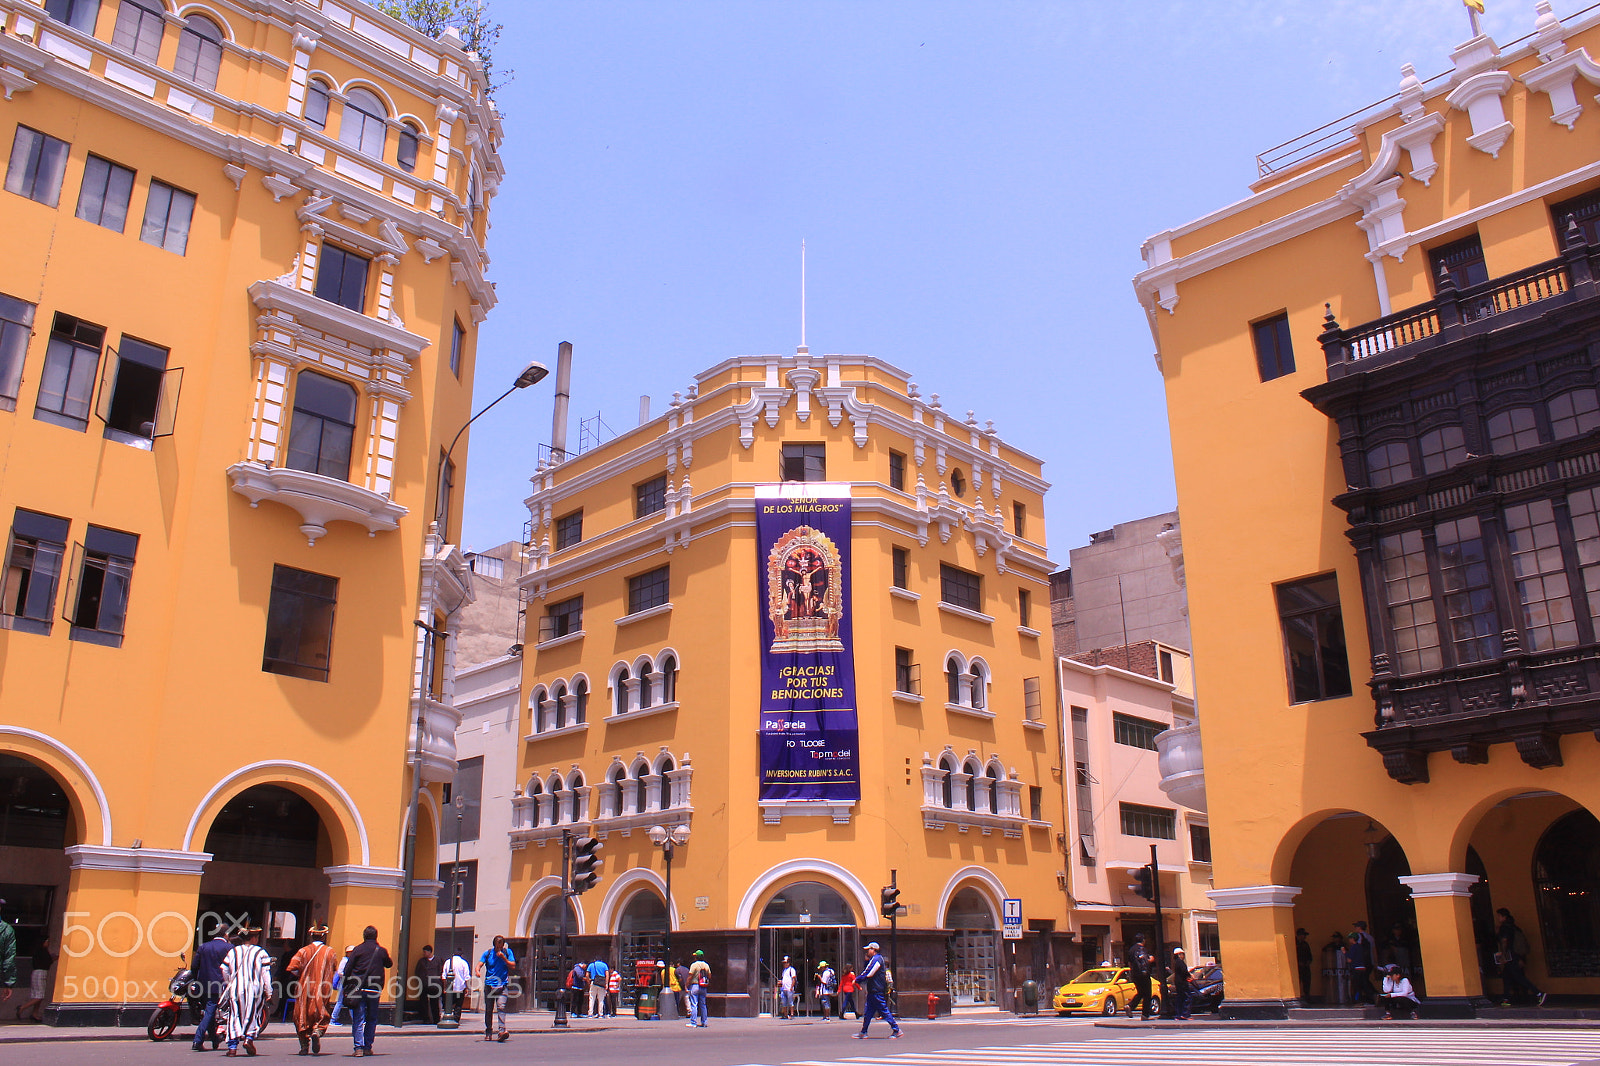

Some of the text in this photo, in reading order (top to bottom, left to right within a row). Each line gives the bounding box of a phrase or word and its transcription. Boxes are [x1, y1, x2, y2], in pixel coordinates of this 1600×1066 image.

[777, 505, 793, 513] LOS
[795, 504, 844, 513] MILAGROS"
[779, 666, 835, 679] ¡GRACIAS!
[786, 677, 828, 688] POR TUS
[771, 688, 844, 700] BENDICIONES
[786, 739, 826, 748] FOTLOOSE
[765, 768, 853, 778] INVERSIONES RUBIN'S S.A.C.
[1009, 902, 1015, 915] T
